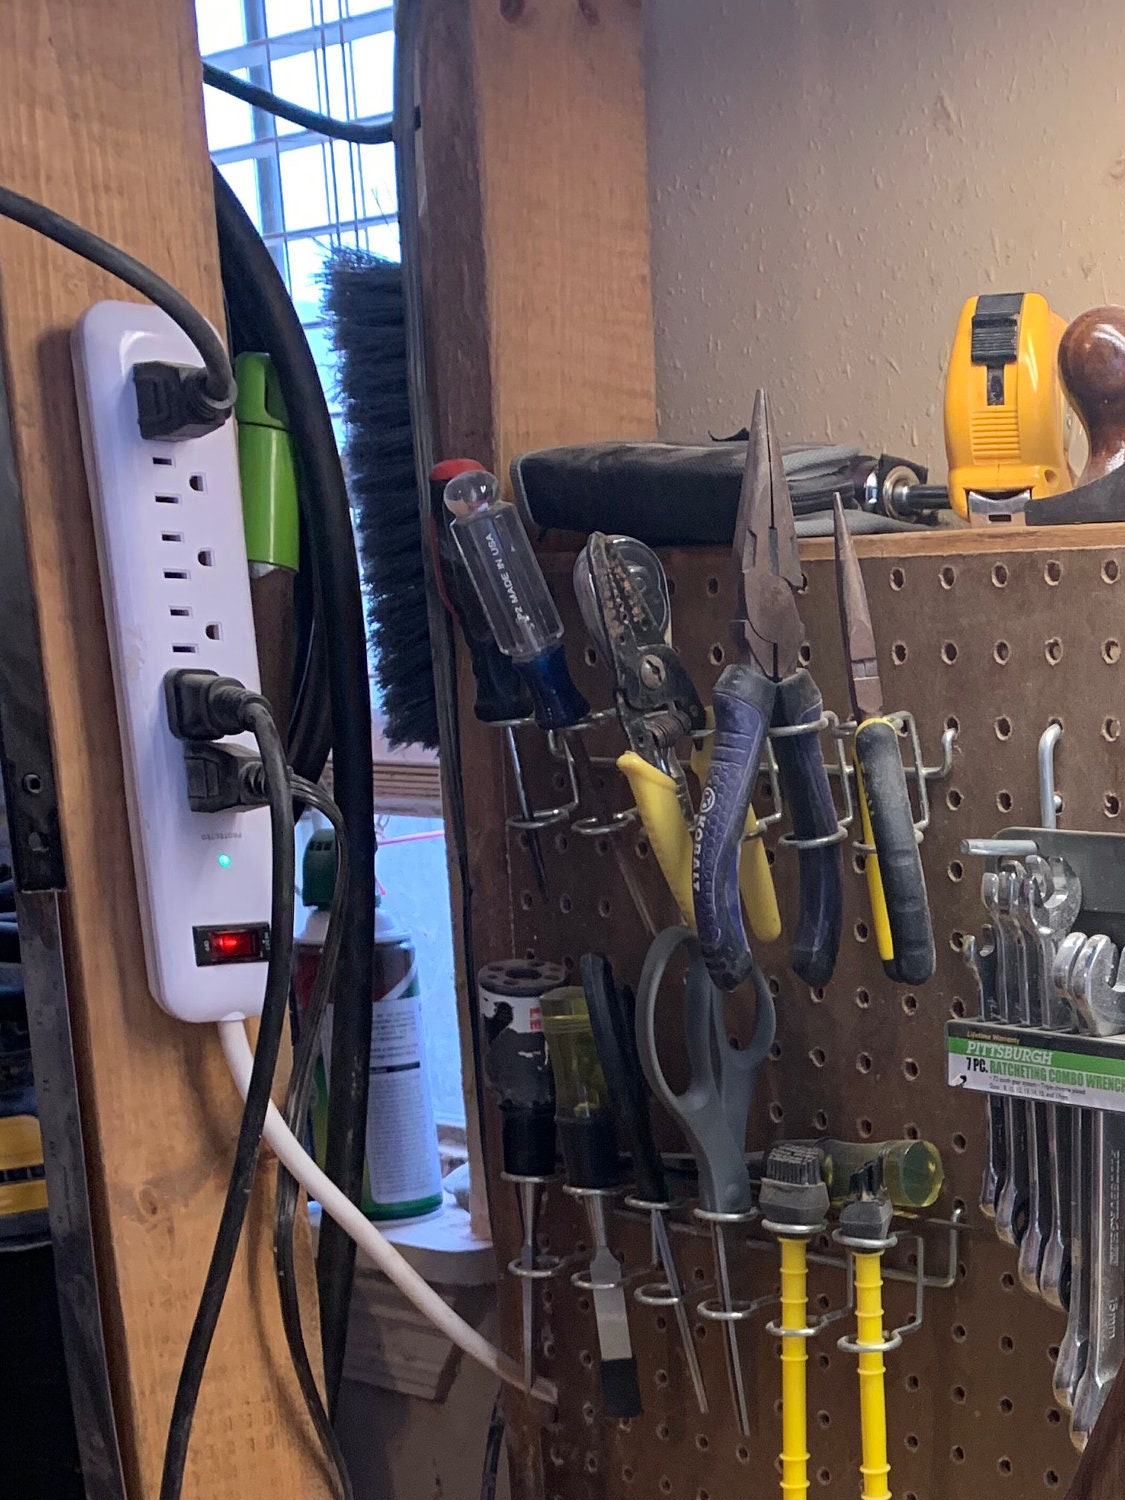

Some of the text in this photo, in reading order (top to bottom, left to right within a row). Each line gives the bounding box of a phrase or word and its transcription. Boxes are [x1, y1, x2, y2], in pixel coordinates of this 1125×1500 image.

[485, 533, 499, 556] USA
[495, 558, 505, 570] IN
[501, 572, 518, 604] MADE
[966, 1041, 1053, 1065] PITTSBURGH
[966, 1057, 972, 1071] 7
[973, 1058, 988, 1073] PC.
[990, 1060, 1048, 1081] RATCHETING
[1049, 1069, 1084, 1087] COMBO
